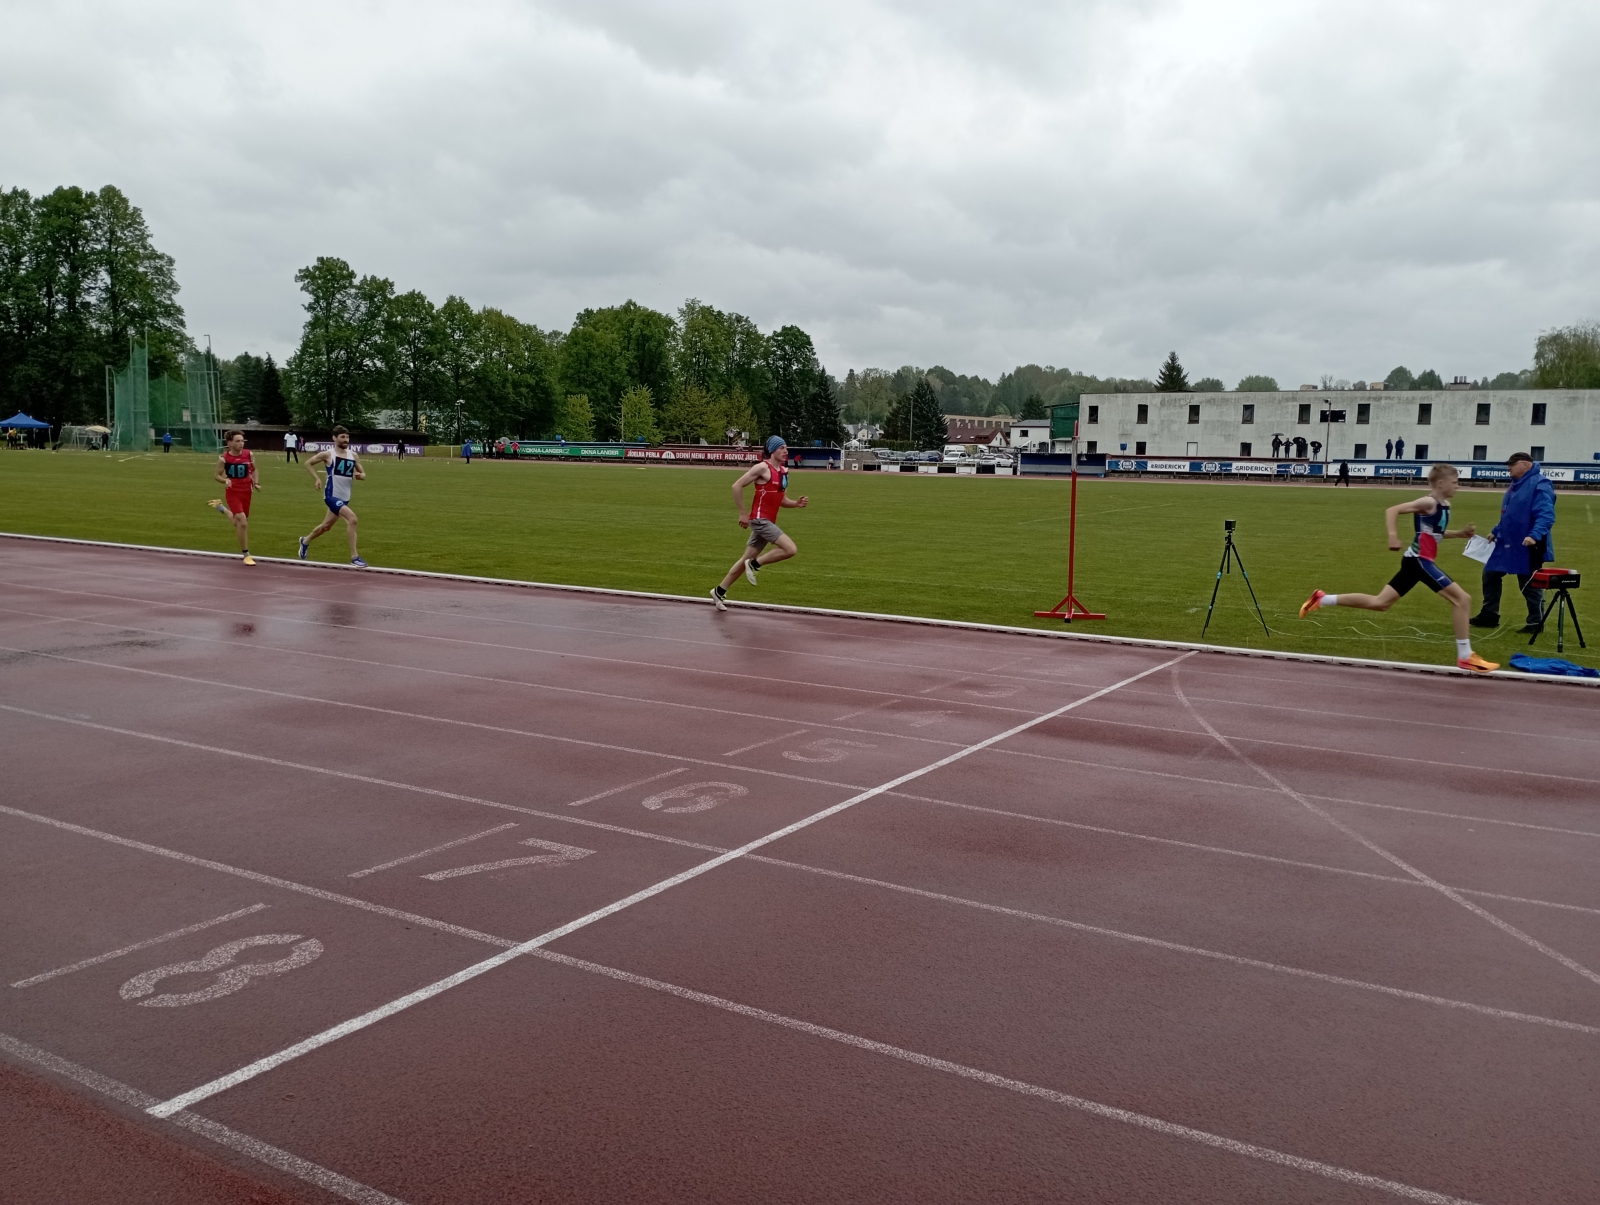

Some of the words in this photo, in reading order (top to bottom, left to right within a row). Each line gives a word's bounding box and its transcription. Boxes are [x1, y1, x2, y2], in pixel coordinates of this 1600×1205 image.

[387, 445, 420, 454] NÁTEK
[676, 451, 690, 459] DENNÍ
[337, 461, 354, 476] 42
[782, 738, 879, 763] 5
[420, 837, 597, 882] 7
[119, 933, 324, 1008] 8
